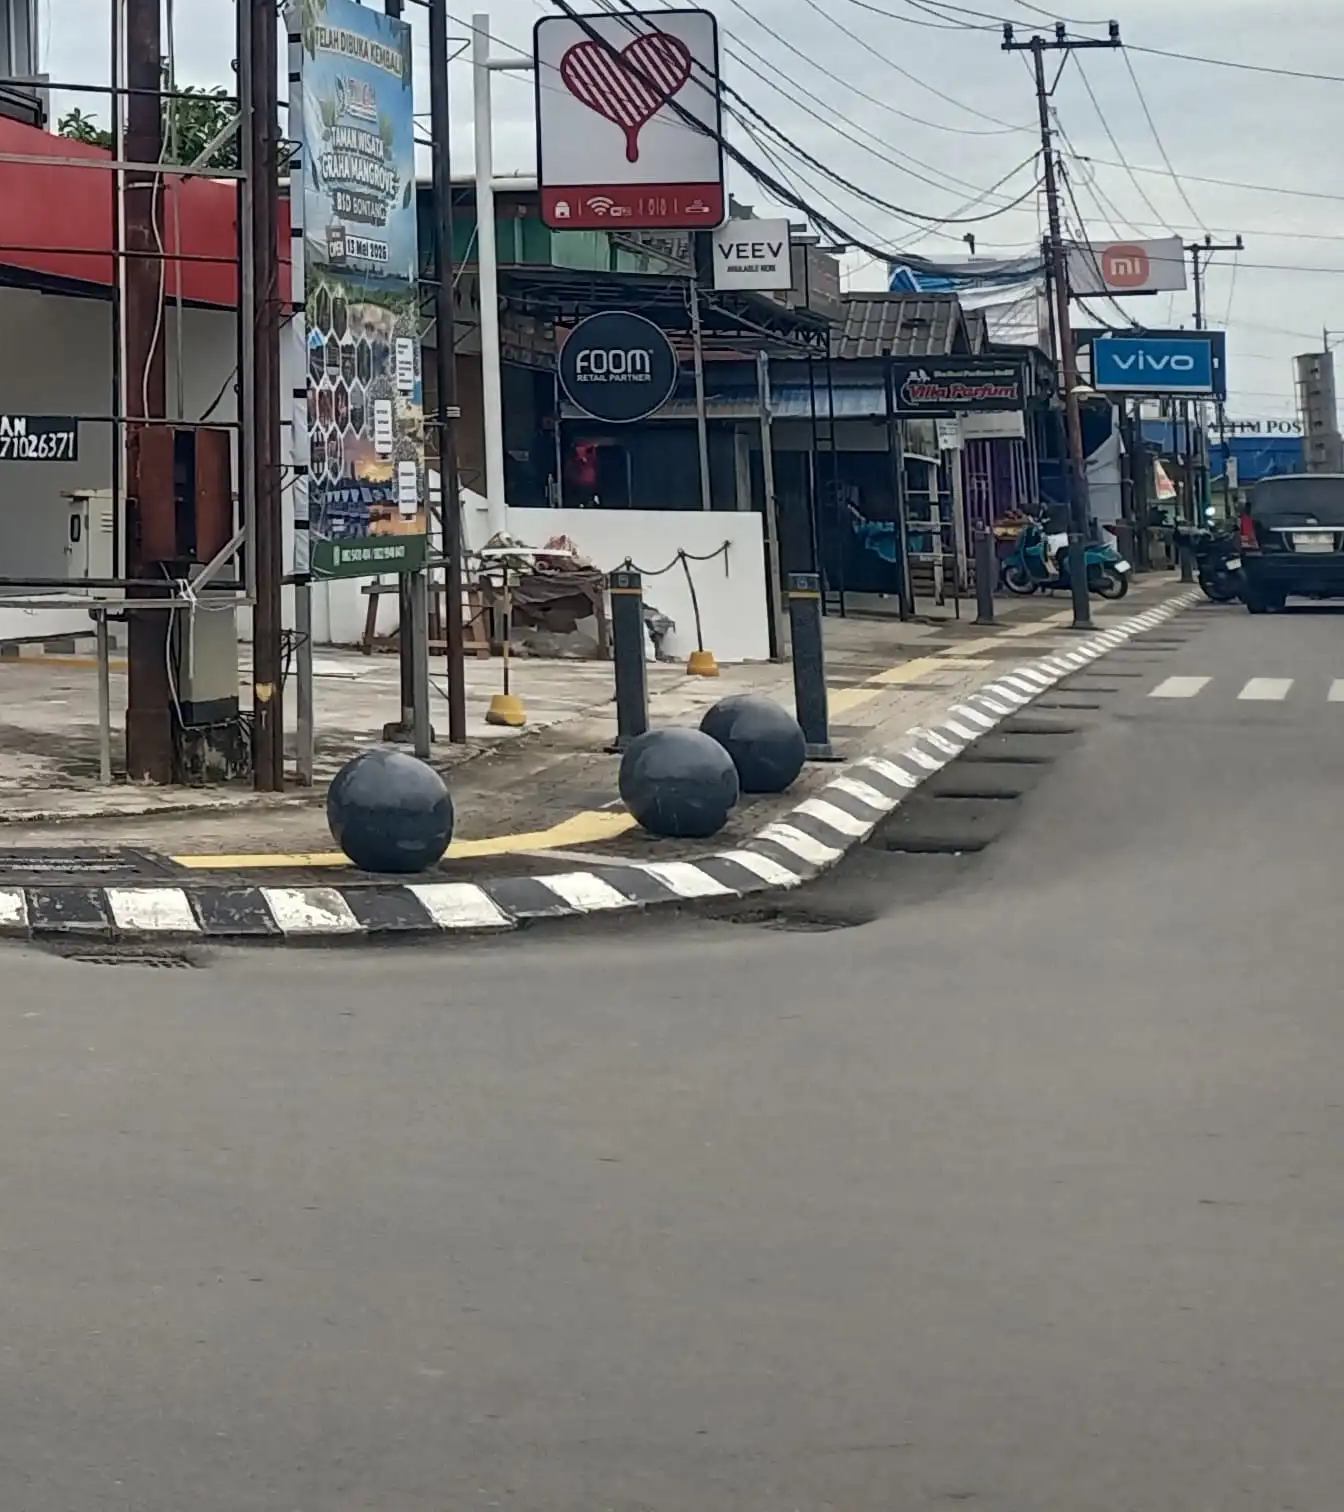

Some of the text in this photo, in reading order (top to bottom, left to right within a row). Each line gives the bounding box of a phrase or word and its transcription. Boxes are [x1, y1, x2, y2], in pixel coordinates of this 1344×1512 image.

[315, 26, 338, 50] TELAH
[340, 31, 369, 59] DIBUKA
[331, 126, 384, 159] TAMAN WISATA
[322, 154, 395, 195] GRAHA MANGROVE
[353, 197, 386, 219] BONTANG
[718, 242, 783, 259] VEEV
[576, 349, 650, 373] FOOM
[1112, 349, 1194, 371] vivo
[577, 374, 651, 382] RETAIL PARTNER
